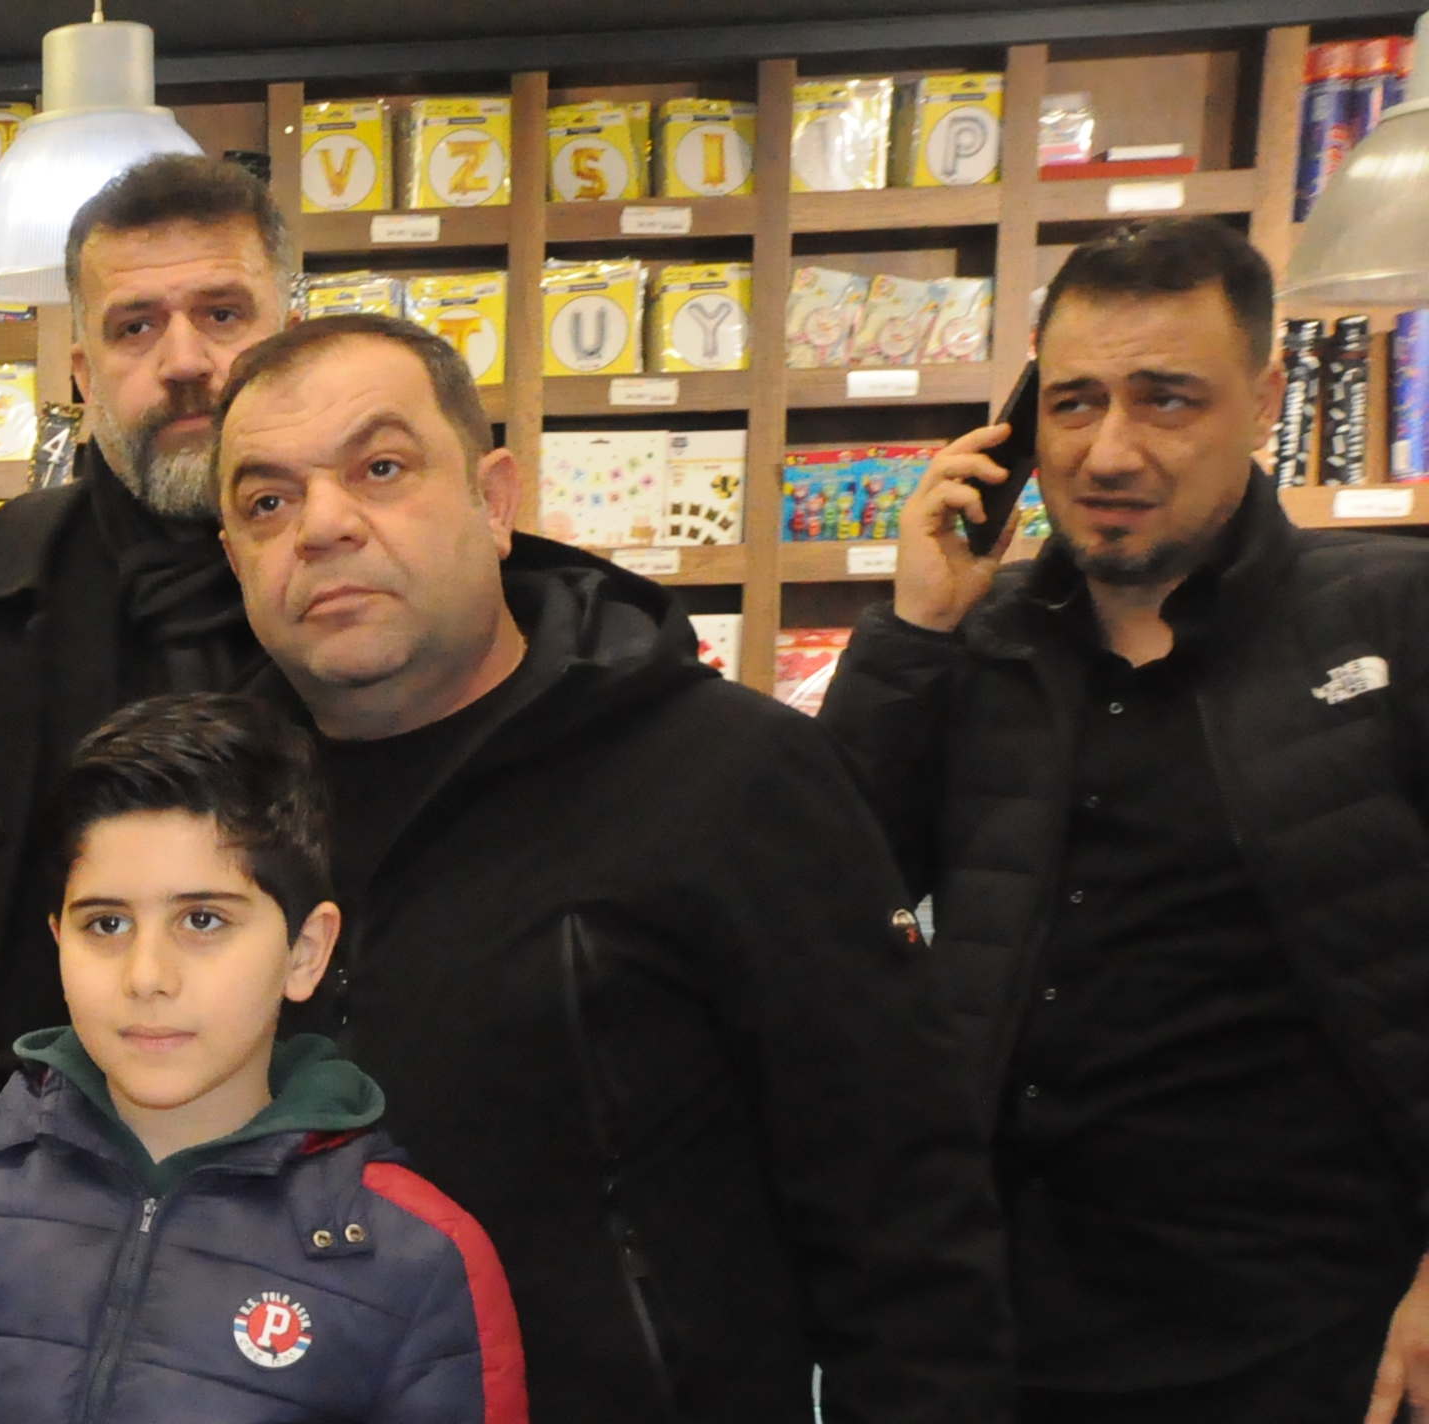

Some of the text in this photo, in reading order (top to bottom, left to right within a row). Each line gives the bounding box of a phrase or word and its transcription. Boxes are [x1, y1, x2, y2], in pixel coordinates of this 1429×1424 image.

[317, 146, 361, 197] V
[448, 139, 490, 195] Z
[942, 116, 988, 177] P
[567, 147, 609, 200] S
[573, 310, 607, 361] U
[688, 301, 732, 358] Y
[256, 1304, 291, 1348] P
